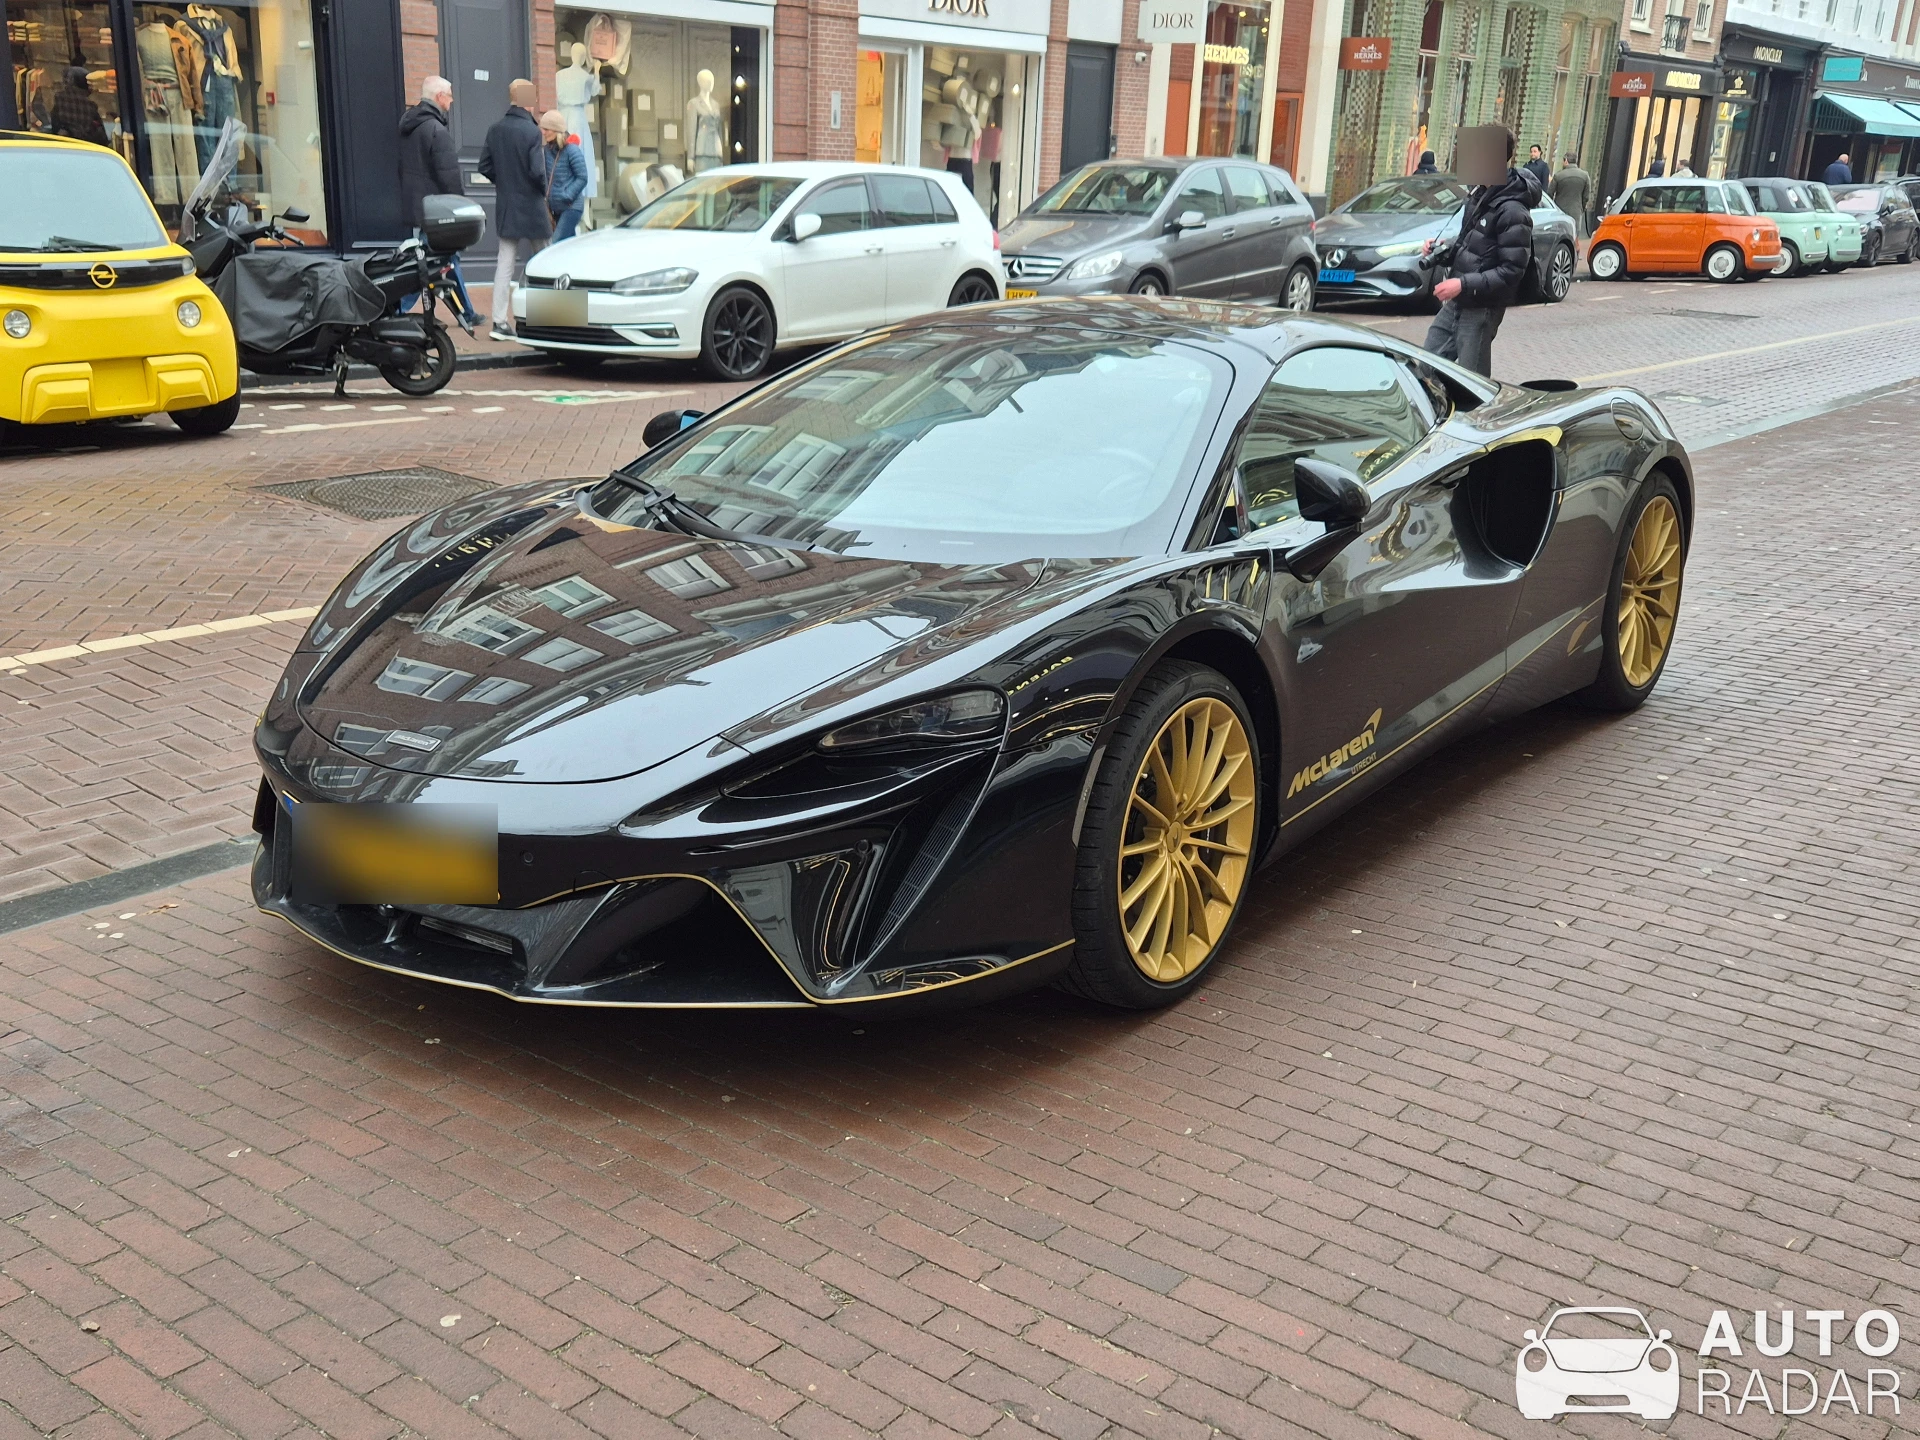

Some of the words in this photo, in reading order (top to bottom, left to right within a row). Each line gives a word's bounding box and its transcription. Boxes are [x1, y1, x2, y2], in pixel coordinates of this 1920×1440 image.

[1152, 12, 1194, 29] DIOR
[1754, 46, 1783, 64] MONCLER
[1286, 729, 1375, 799] McLaren
[1351, 751, 1377, 775] UTRECHT
